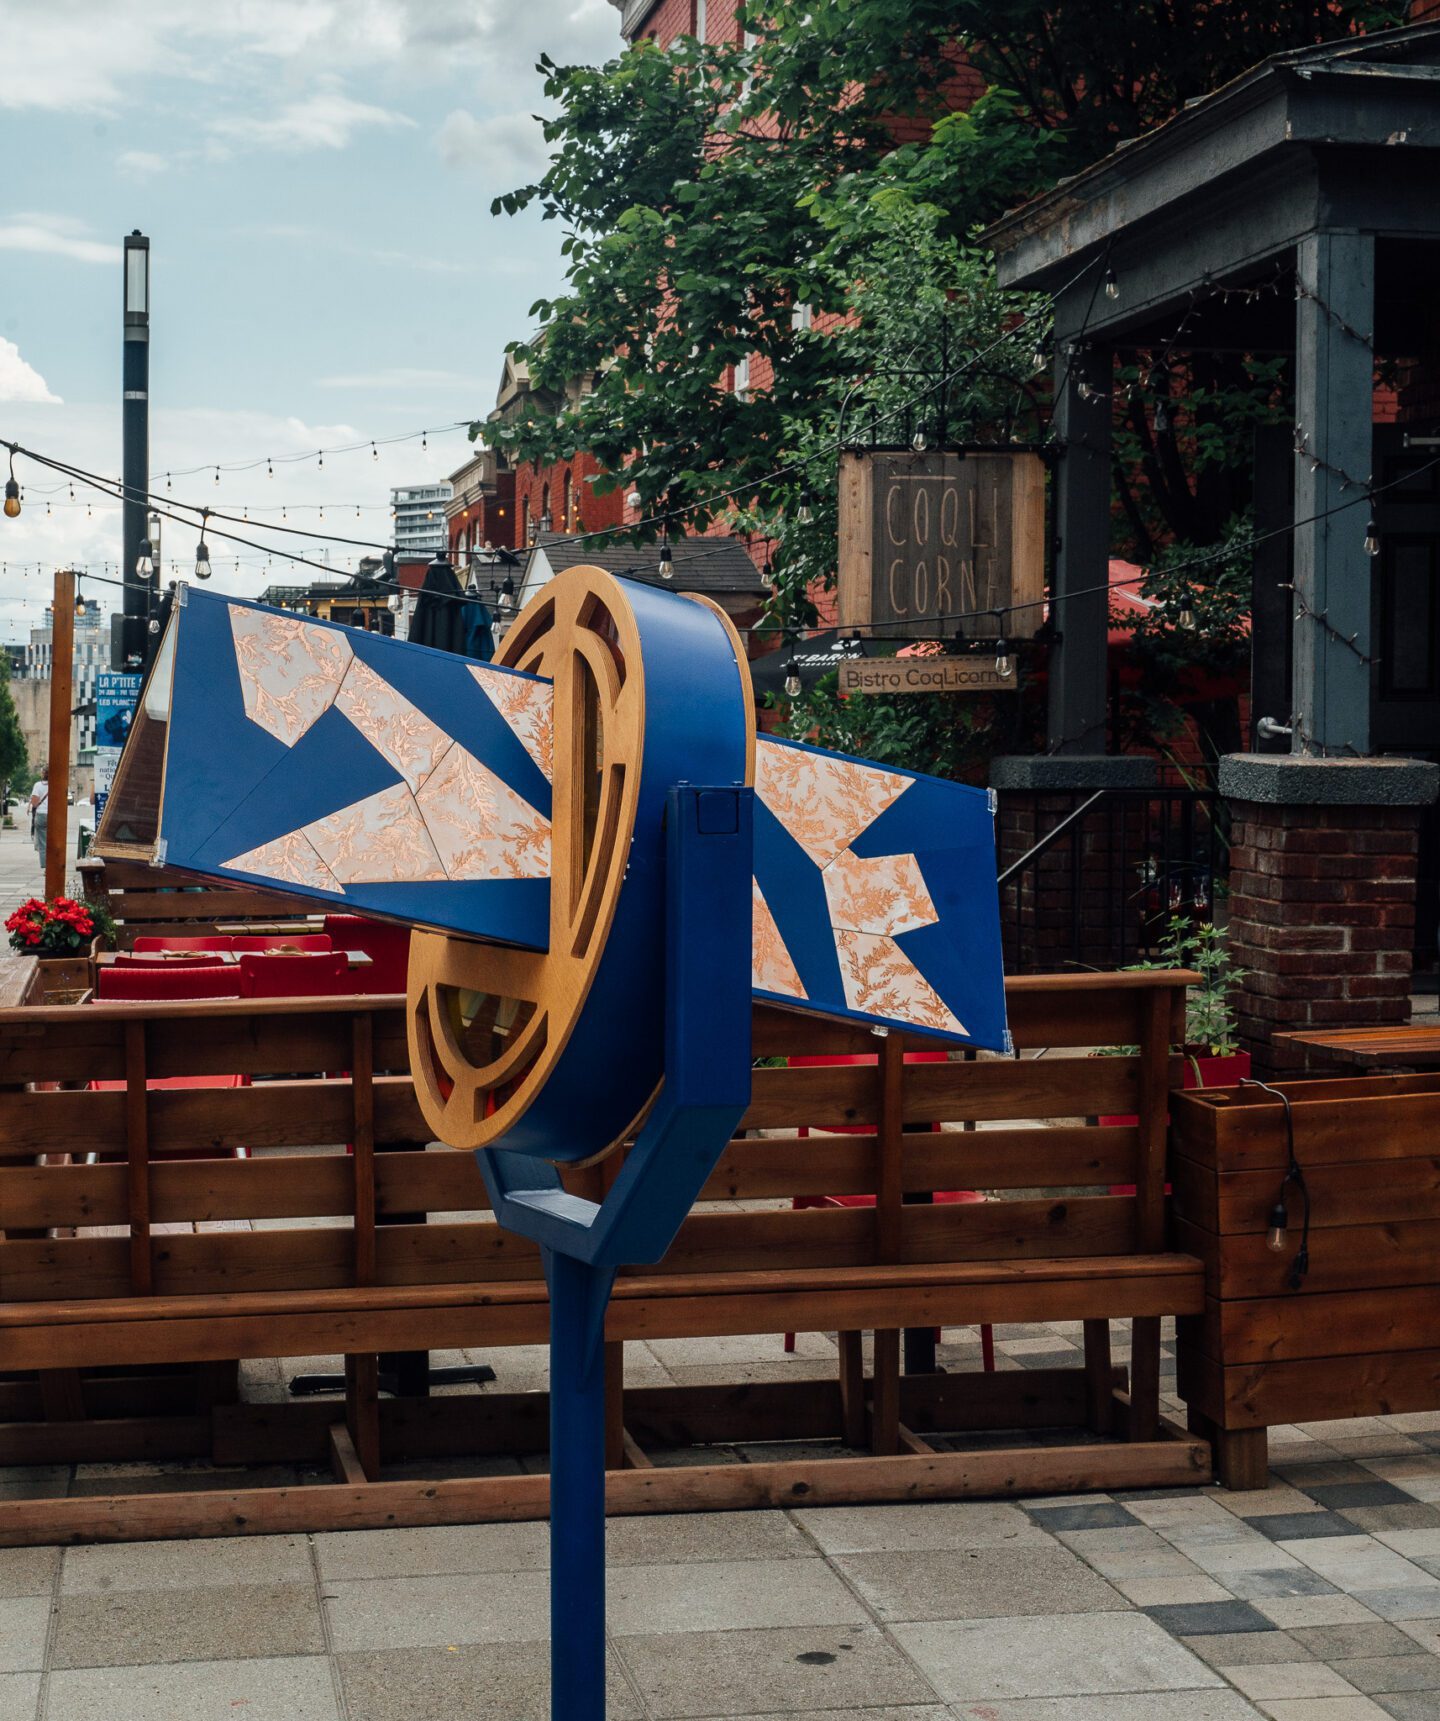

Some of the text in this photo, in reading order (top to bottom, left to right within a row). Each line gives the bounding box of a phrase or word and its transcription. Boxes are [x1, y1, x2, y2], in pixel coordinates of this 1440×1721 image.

[99, 676, 109, 688] LA
[111, 676, 136, 688] P'TITE
[846, 670, 901, 688] Bistro
